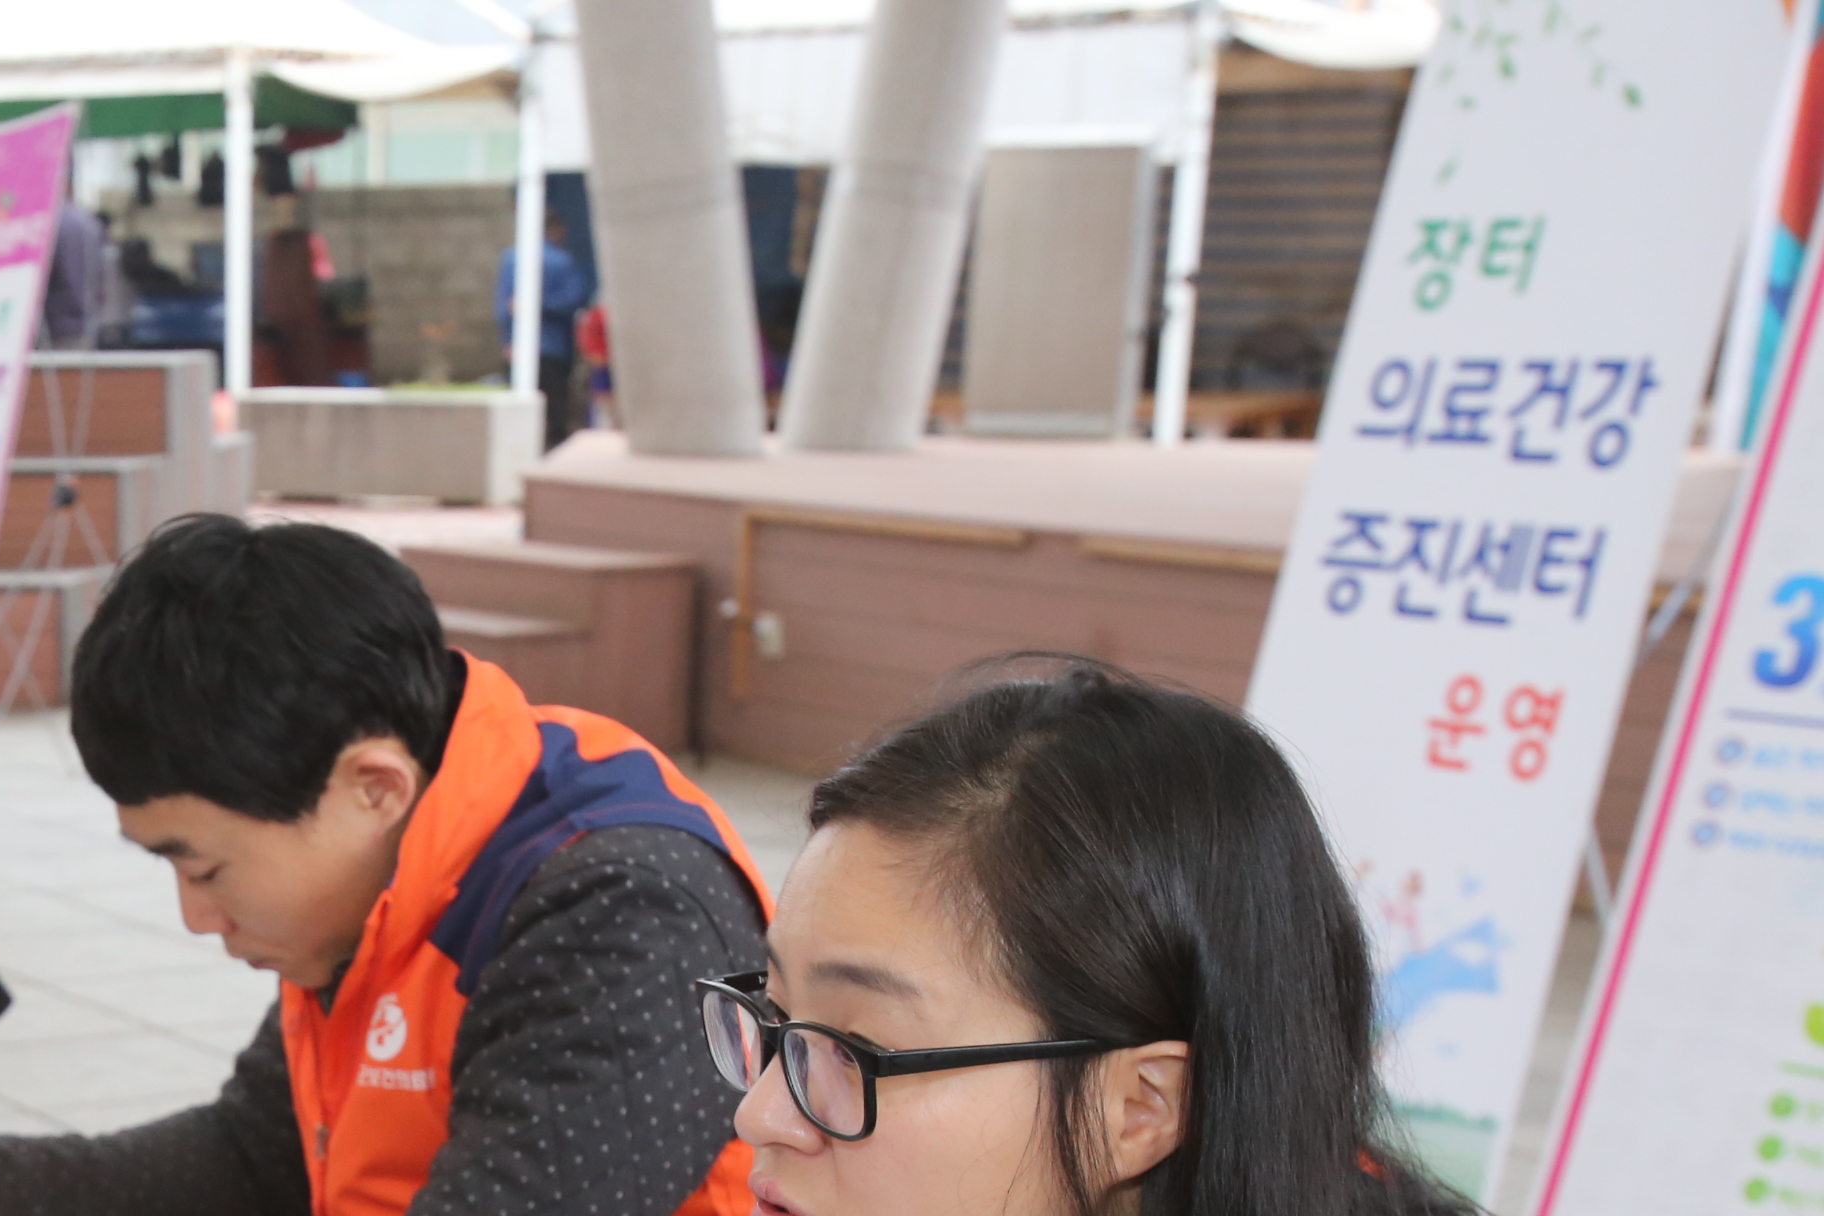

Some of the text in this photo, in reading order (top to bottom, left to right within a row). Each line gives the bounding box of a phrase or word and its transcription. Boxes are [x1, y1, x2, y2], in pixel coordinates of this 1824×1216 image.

[1406, 215, 1547, 311] 장터
[1356, 356, 1660, 469] 의료건강
[1321, 509, 1607, 626] 증진센터
[1427, 674, 1565, 782] 운영
